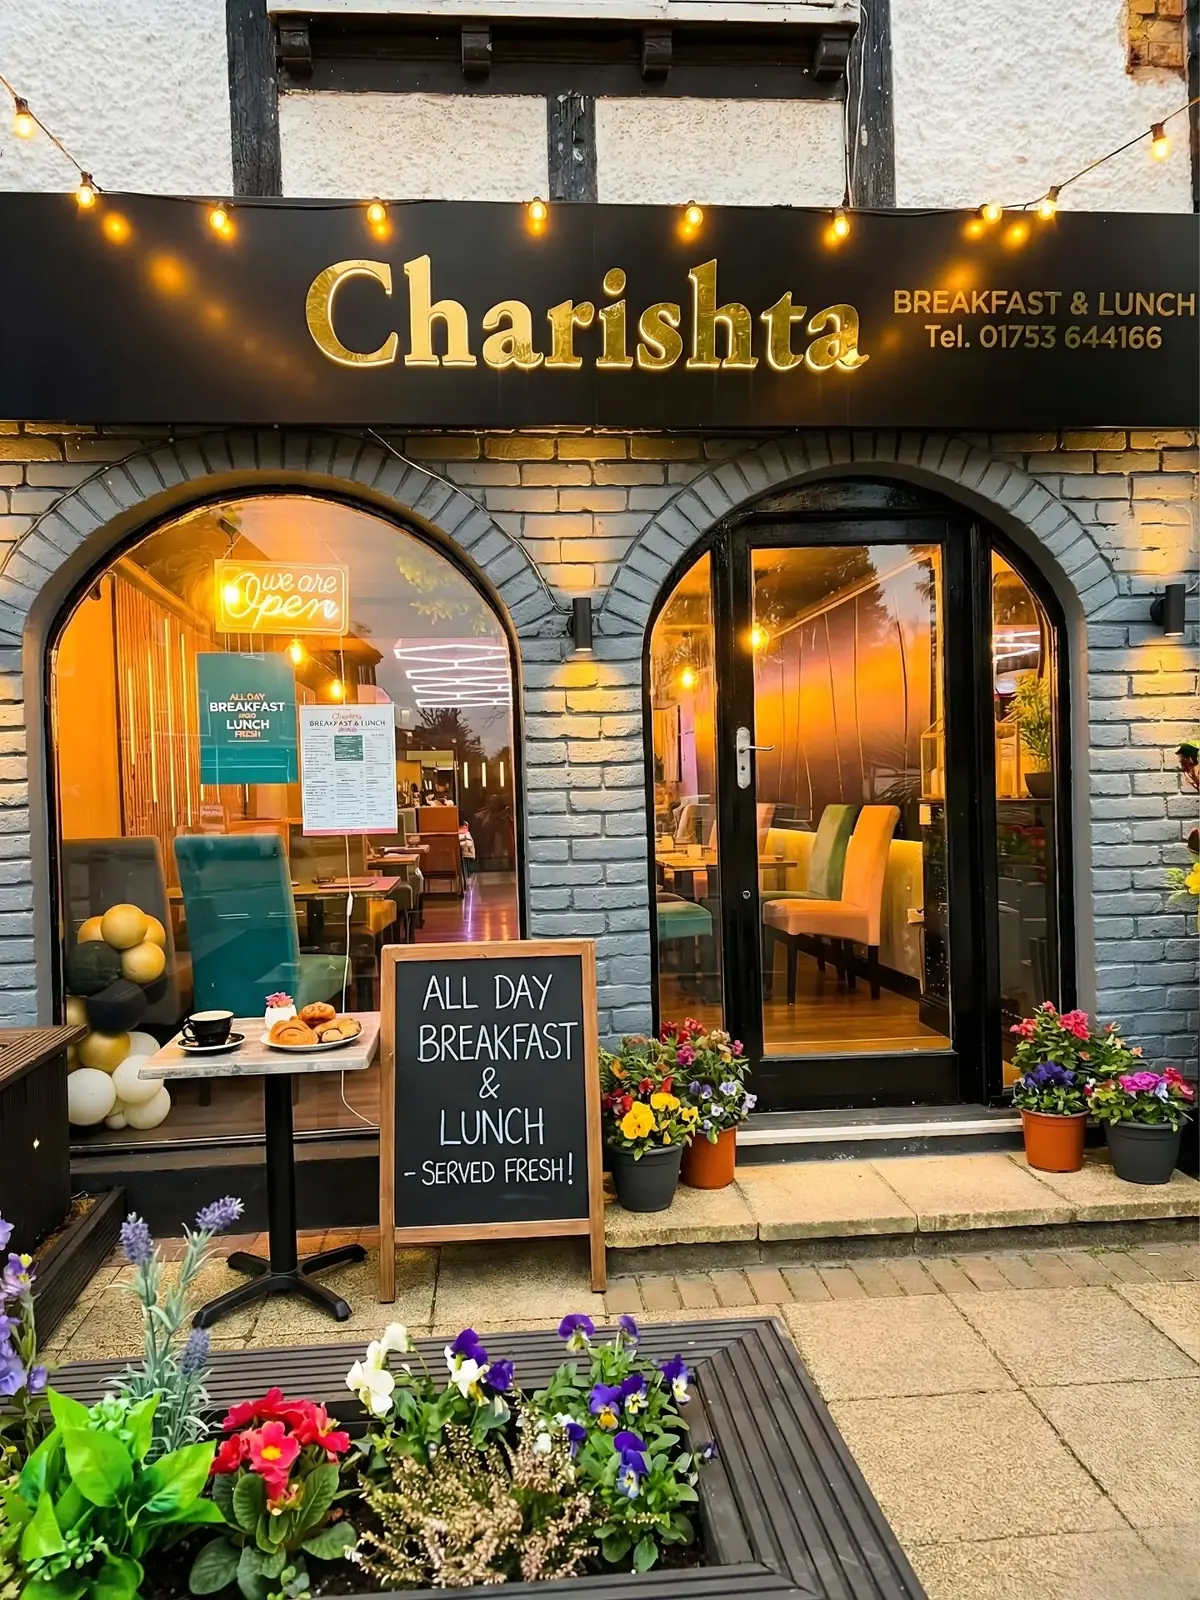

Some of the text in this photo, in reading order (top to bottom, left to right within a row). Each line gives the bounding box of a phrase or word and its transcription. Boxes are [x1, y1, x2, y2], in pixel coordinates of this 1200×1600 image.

[305, 254, 869, 371] Charishta
[894, 290, 1196, 317] BREAKFAST & LUNCH
[924, 324, 1163, 349] Tel. 01753 644166
[262, 572, 338, 594] we are
[224, 573, 339, 629] Open
[209, 702, 285, 712] BREAKFAST
[229, 693, 247, 701] ALL
[226, 719, 270, 730] LUNCH
[422, 973, 553, 1011] ALL DAY
[417, 1022, 579, 1063] BREAKFAST
[479, 1066, 500, 1099] &
[440, 1107, 544, 1146] LUNCH
[504, 1152, 573, 1186] FRESH!
